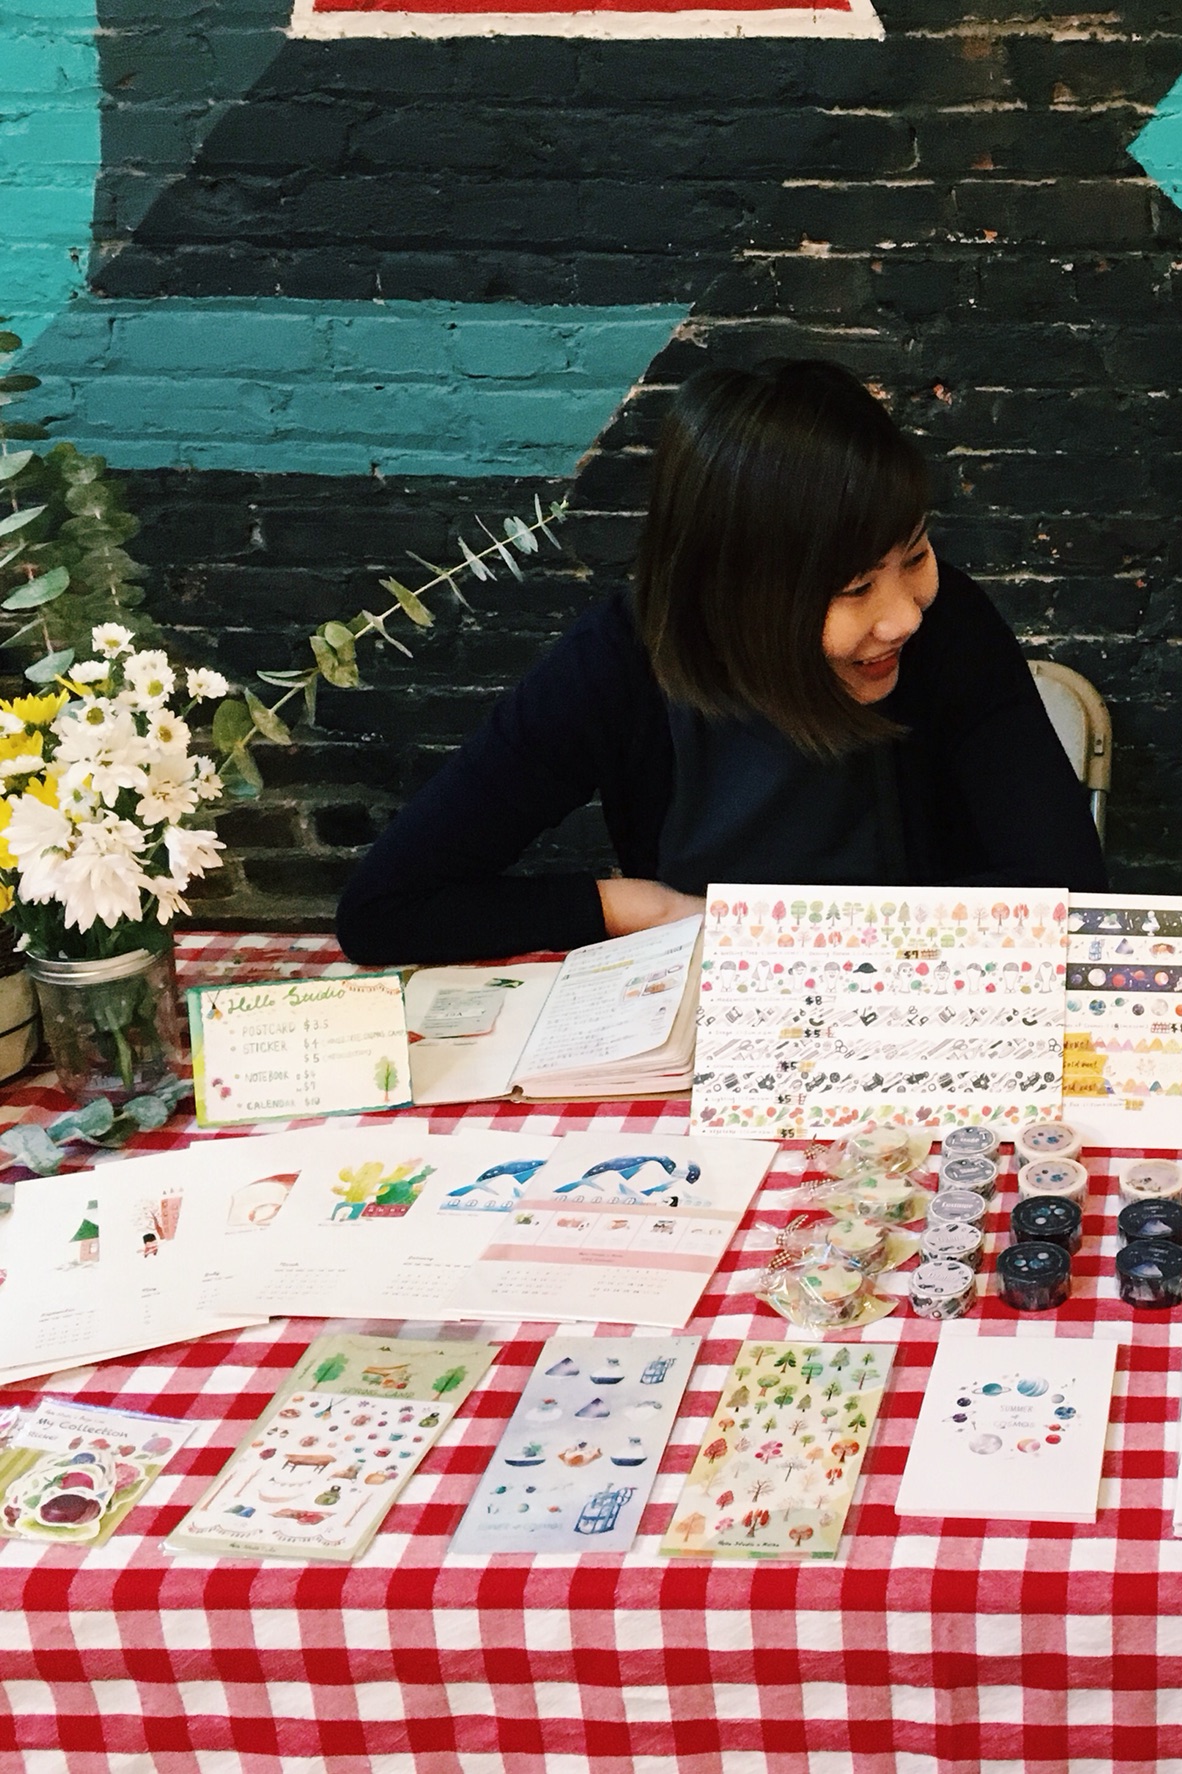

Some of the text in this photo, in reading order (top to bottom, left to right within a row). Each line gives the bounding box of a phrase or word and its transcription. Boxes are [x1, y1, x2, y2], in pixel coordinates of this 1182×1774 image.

[228, 986, 346, 1014] Hello Studio
[804, 995, 823, 1006] $8
[242, 1022, 296, 1037] POSTCARD
[804, 1028, 821, 1038] $5
[242, 1041, 287, 1055] STICKER
[781, 1061, 798, 1072] $5
[245, 1070, 289, 1083] NOTEBOOK
[246, 1098, 296, 1111] CALENDAR
[777, 1094, 792, 1104] $5
[781, 1128, 795, 1138] $5
[37, 1418, 128, 1438] My Collection
